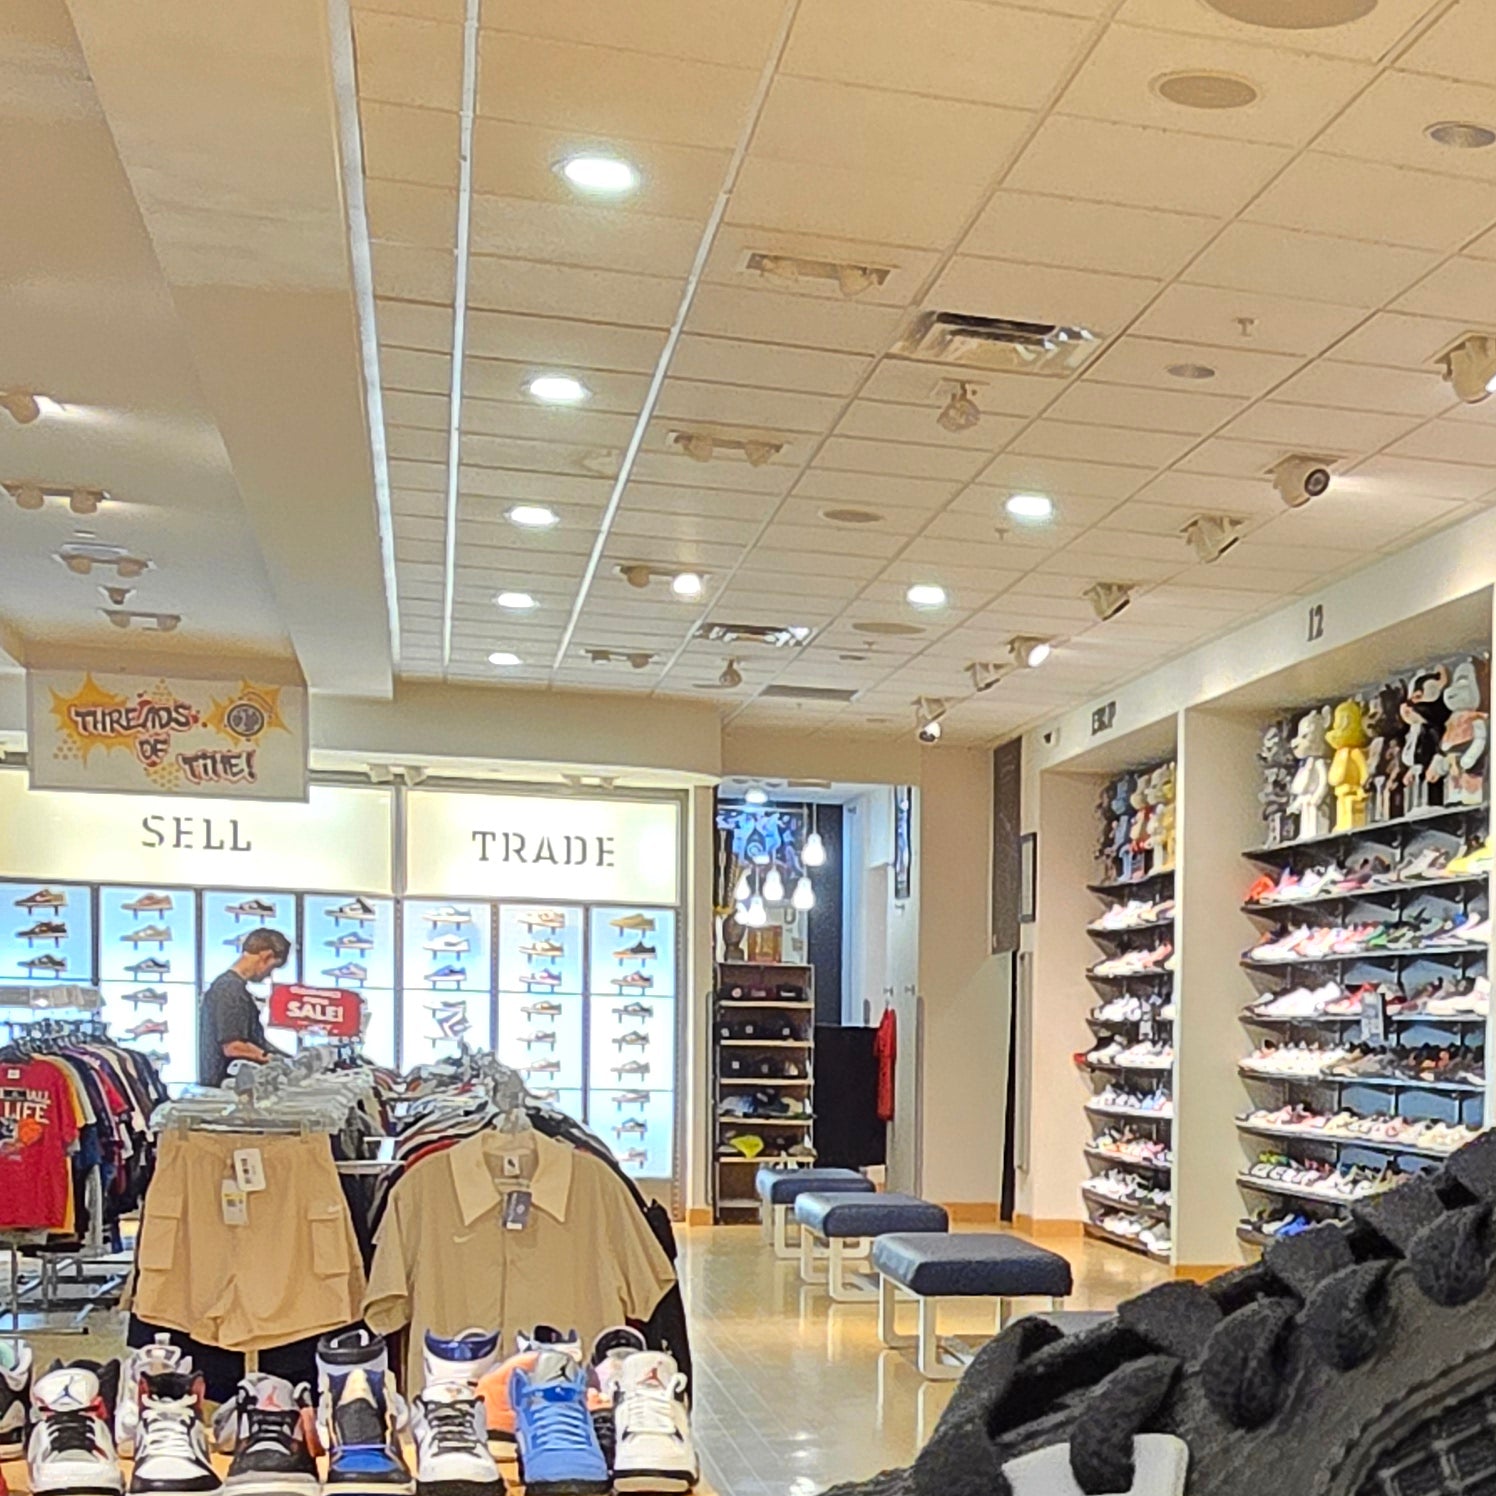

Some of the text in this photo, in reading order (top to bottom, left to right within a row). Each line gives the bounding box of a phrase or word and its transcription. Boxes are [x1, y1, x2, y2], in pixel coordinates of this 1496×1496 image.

[73, 702, 193, 733] THREADS
[138, 738, 169, 759] OF
[141, 814, 252, 852] SELL
[471, 830, 615, 867] TRADE
